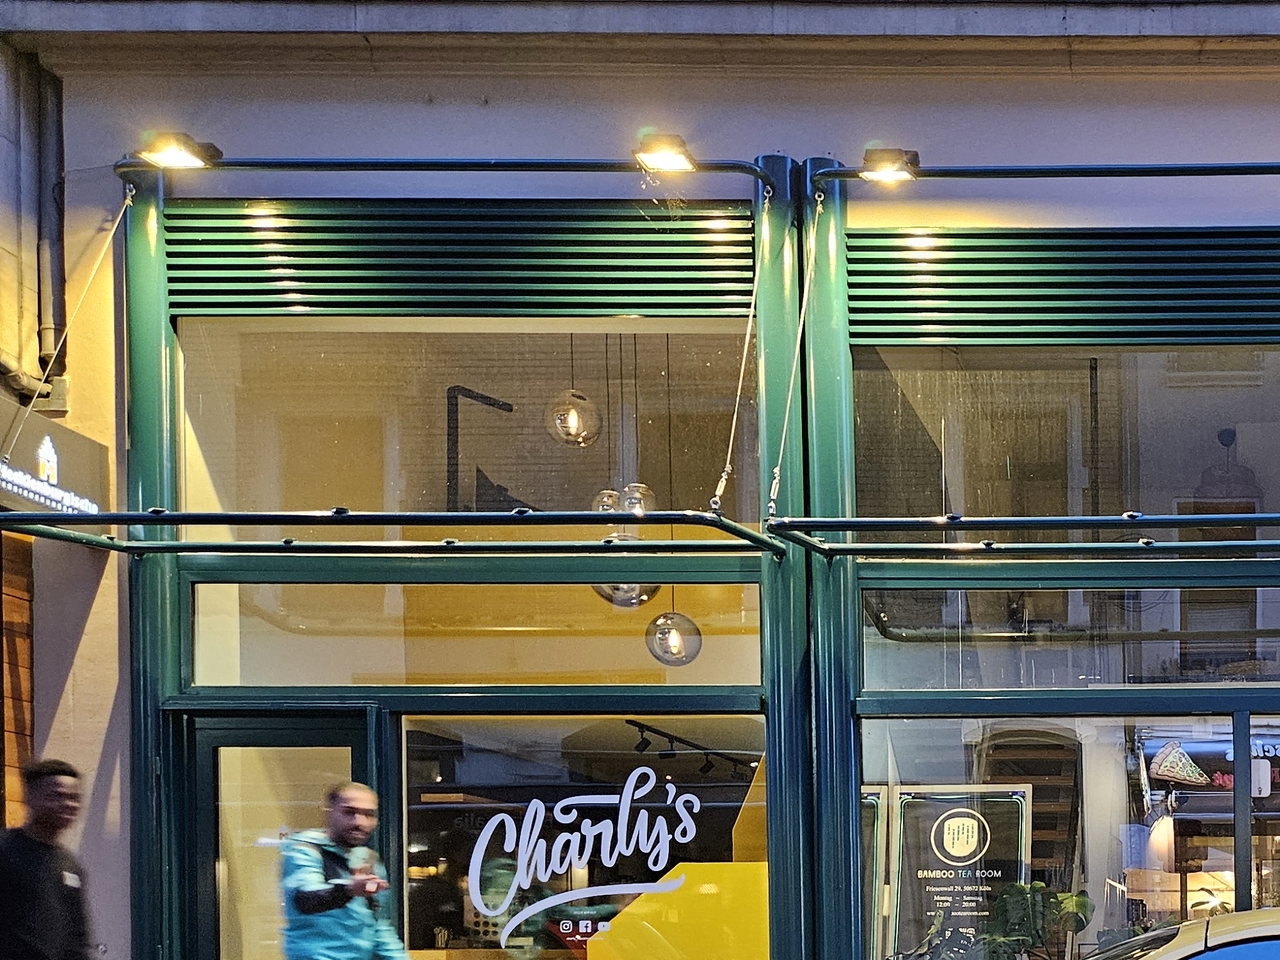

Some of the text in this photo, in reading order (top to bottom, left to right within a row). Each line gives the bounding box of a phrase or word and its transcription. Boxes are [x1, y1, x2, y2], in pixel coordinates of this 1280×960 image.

[468, 766, 700, 917] Charly's
[917, 869, 1002, 879] BAMBOO TEA ROOM
